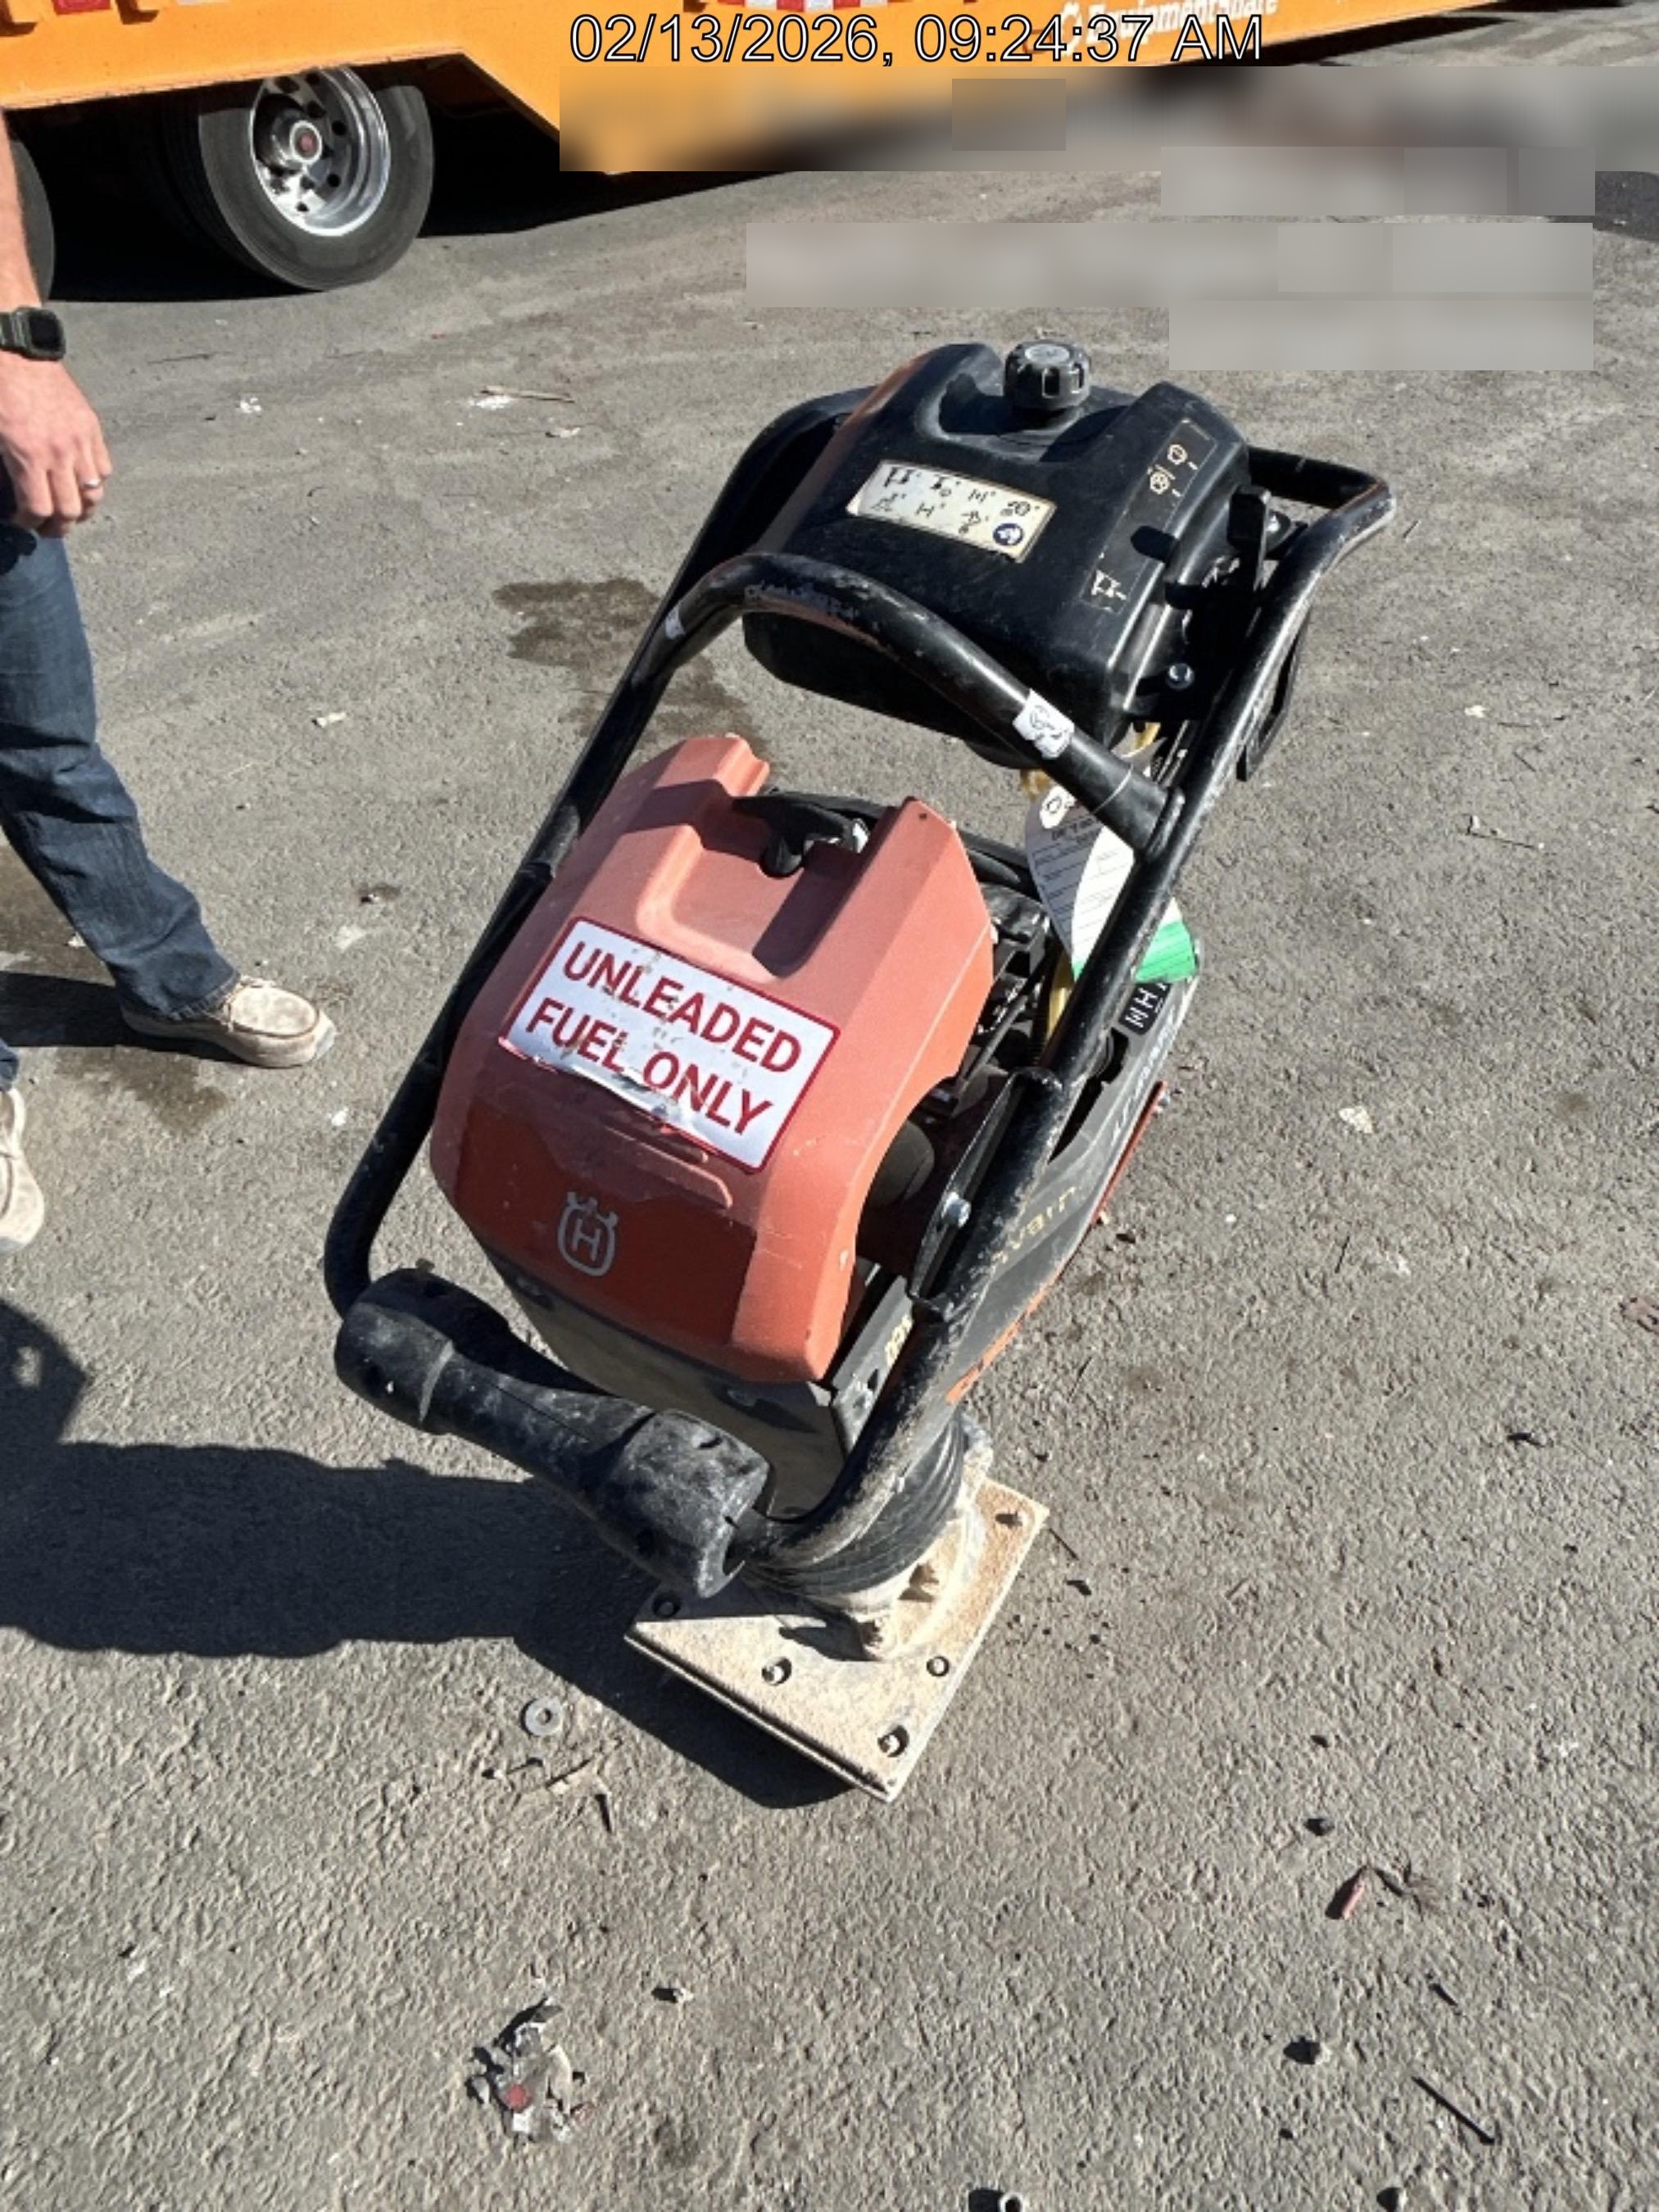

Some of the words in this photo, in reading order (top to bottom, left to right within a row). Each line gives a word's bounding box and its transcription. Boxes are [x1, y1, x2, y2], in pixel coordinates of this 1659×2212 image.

[525, 997, 628, 1072] FUEL
[642, 1049, 773, 1135] ONLY
[564, 941, 802, 1073] UNLEADED
